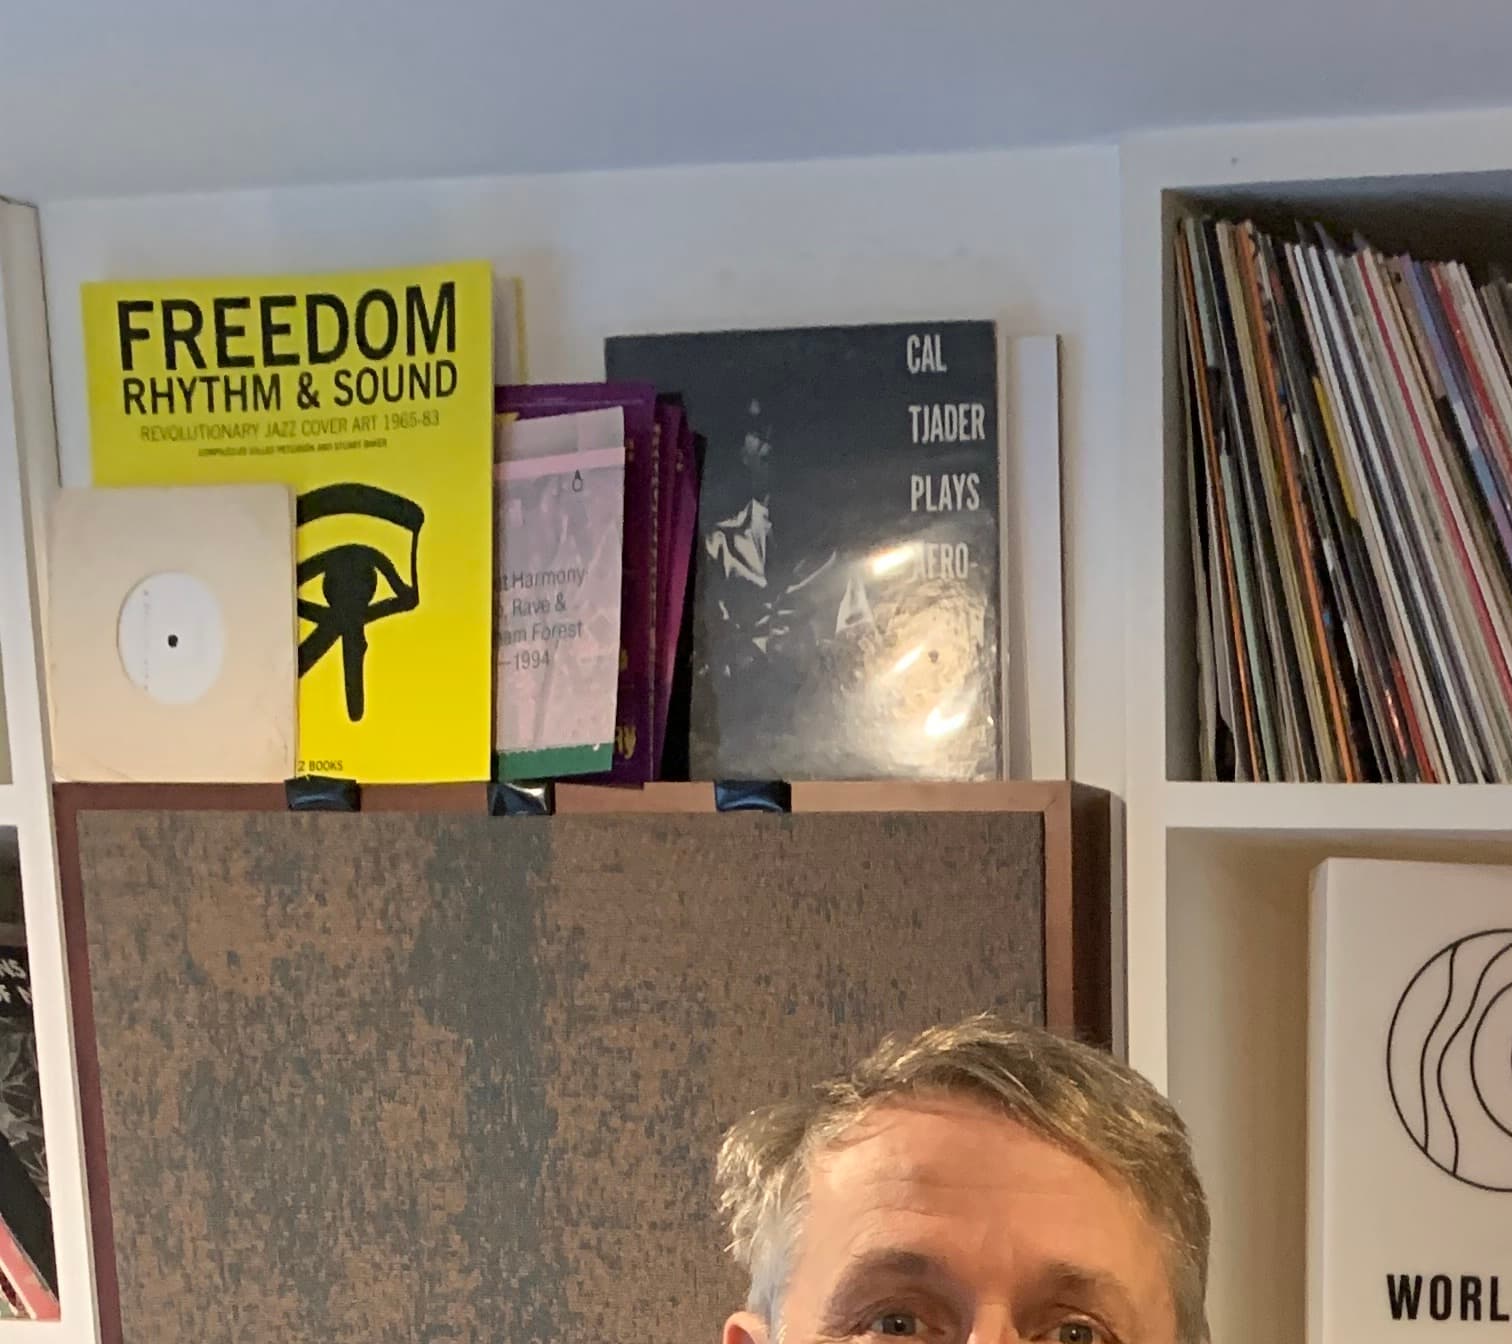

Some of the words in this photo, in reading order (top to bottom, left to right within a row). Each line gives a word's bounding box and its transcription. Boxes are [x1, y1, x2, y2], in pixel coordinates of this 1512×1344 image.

[117, 281, 456, 371] FREEDOM
[907, 334, 948, 374] CAL
[122, 373, 281, 415] RHYTHM
[296, 371, 320, 410] &
[333, 359, 457, 407] SOUND
[140, 421, 260, 442] REVOLUTIONARY
[264, 419, 297, 438] JAZZ
[301, 417, 347, 436] COVER
[351, 415, 378, 433] ART
[908, 403, 986, 444] TJADER
[911, 473, 981, 512] PLAYS
[512, 567, 586, 589] Harmony
[512, 598, 551, 617] Rave
[554, 592, 567, 613] &
[531, 620, 583, 641] Forest
[308, 760, 344, 772] BOOKS
